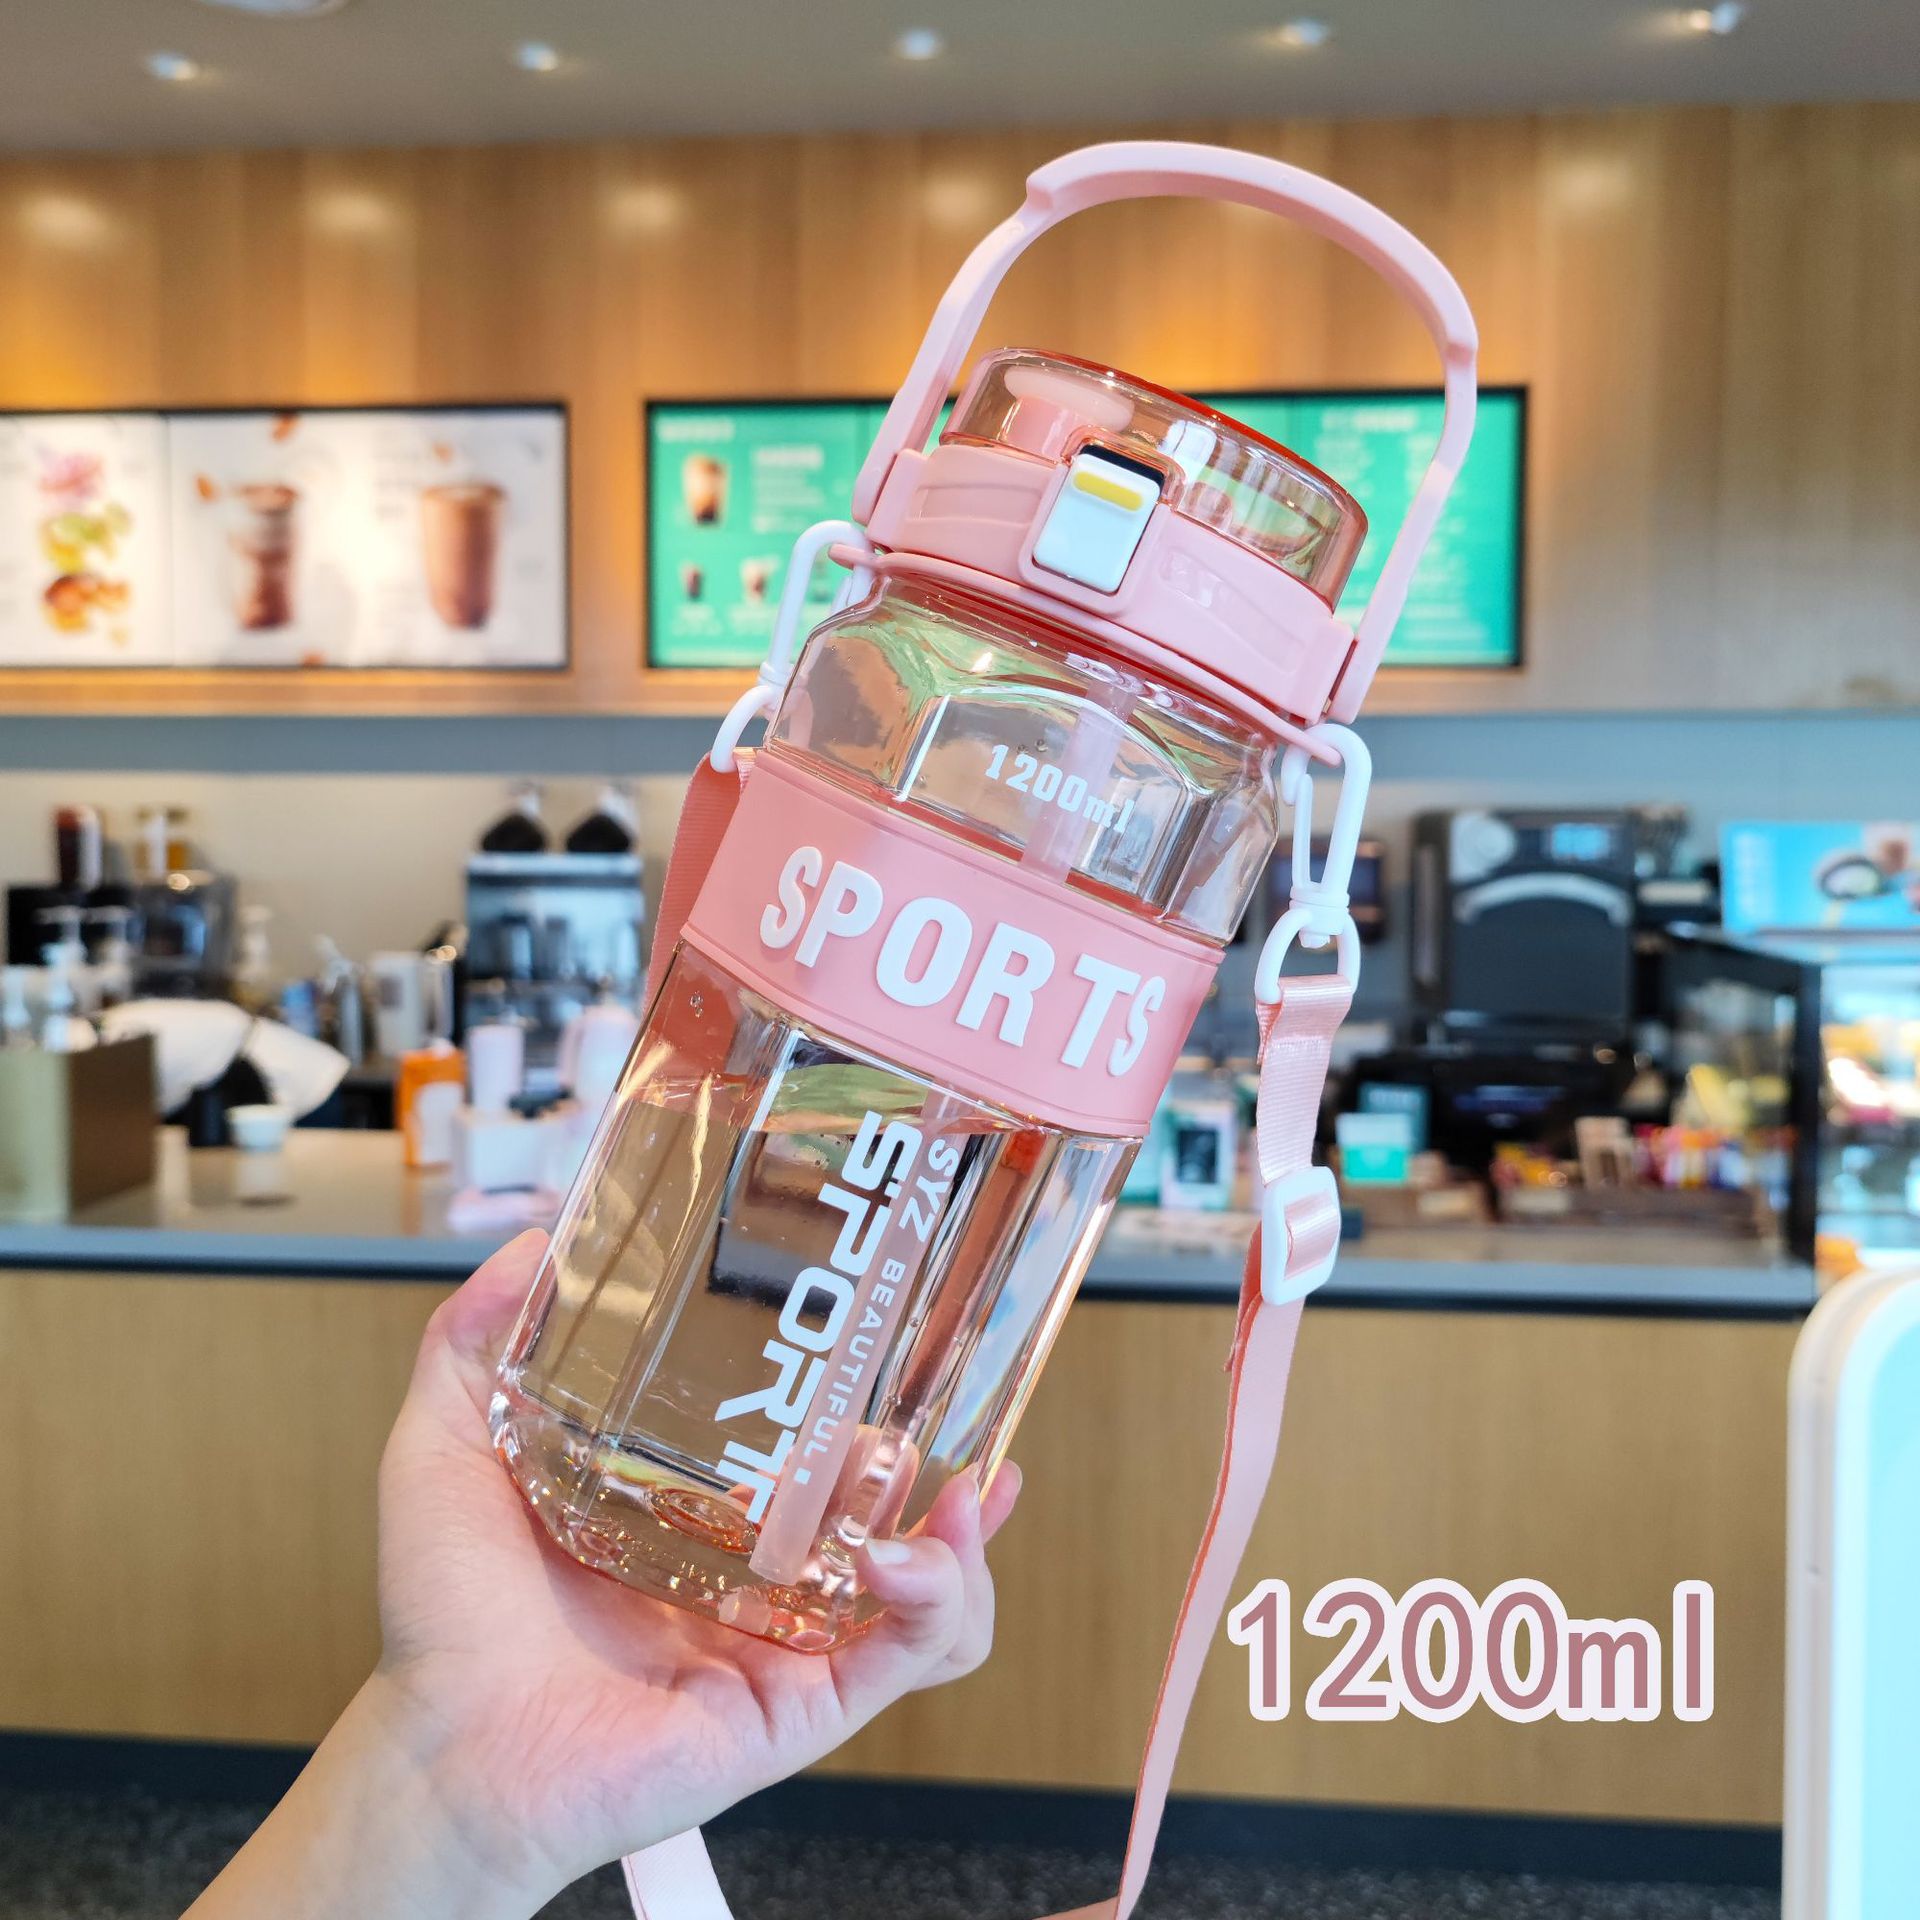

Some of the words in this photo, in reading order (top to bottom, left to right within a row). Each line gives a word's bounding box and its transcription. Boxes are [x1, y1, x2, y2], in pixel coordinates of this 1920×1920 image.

[985, 744, 1135, 834] 1200ml
[760, 846, 1166, 1077] SPORTS
[898, 1138, 960, 1242] SYZ
